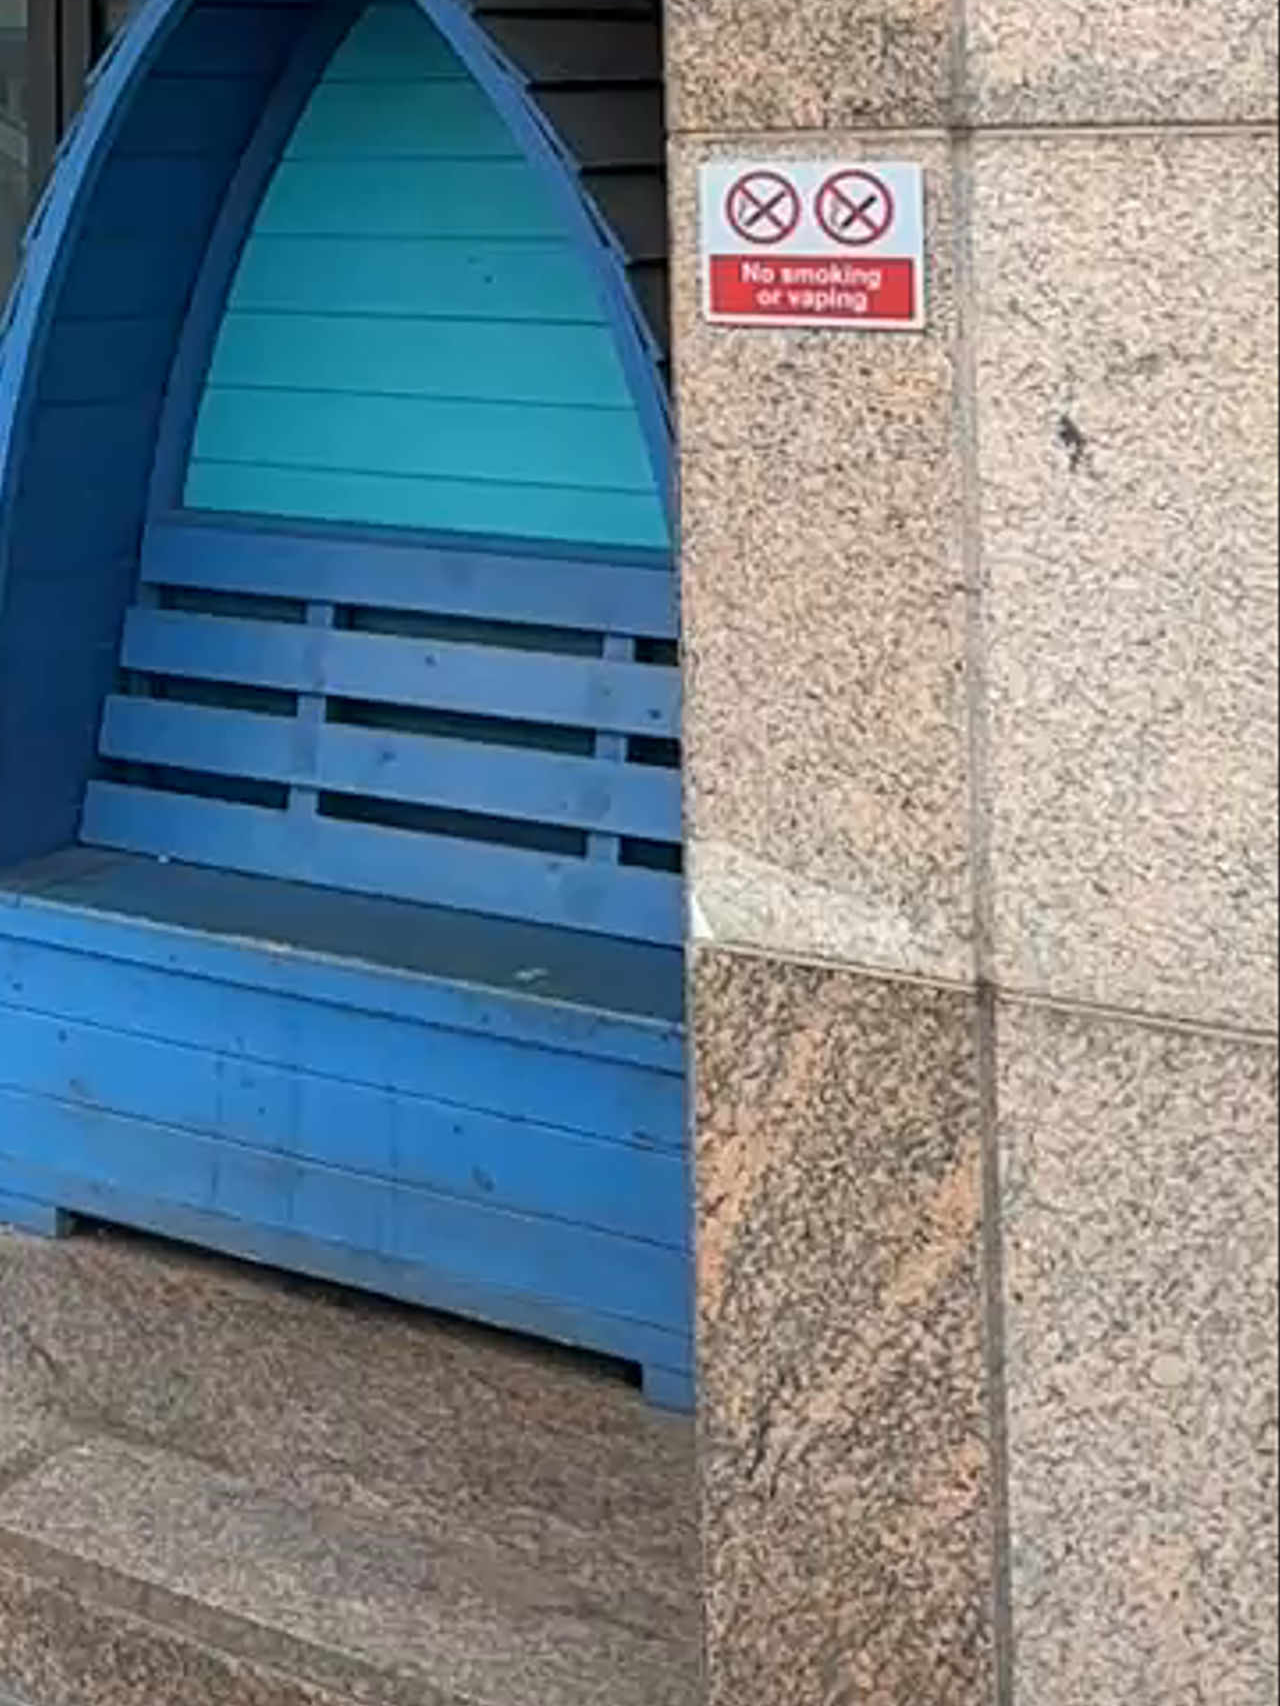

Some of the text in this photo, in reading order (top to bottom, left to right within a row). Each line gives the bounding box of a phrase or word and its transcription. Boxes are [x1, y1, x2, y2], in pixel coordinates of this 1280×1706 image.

[741, 261, 882, 291] No smoking
[755, 288, 868, 313] or vaping
